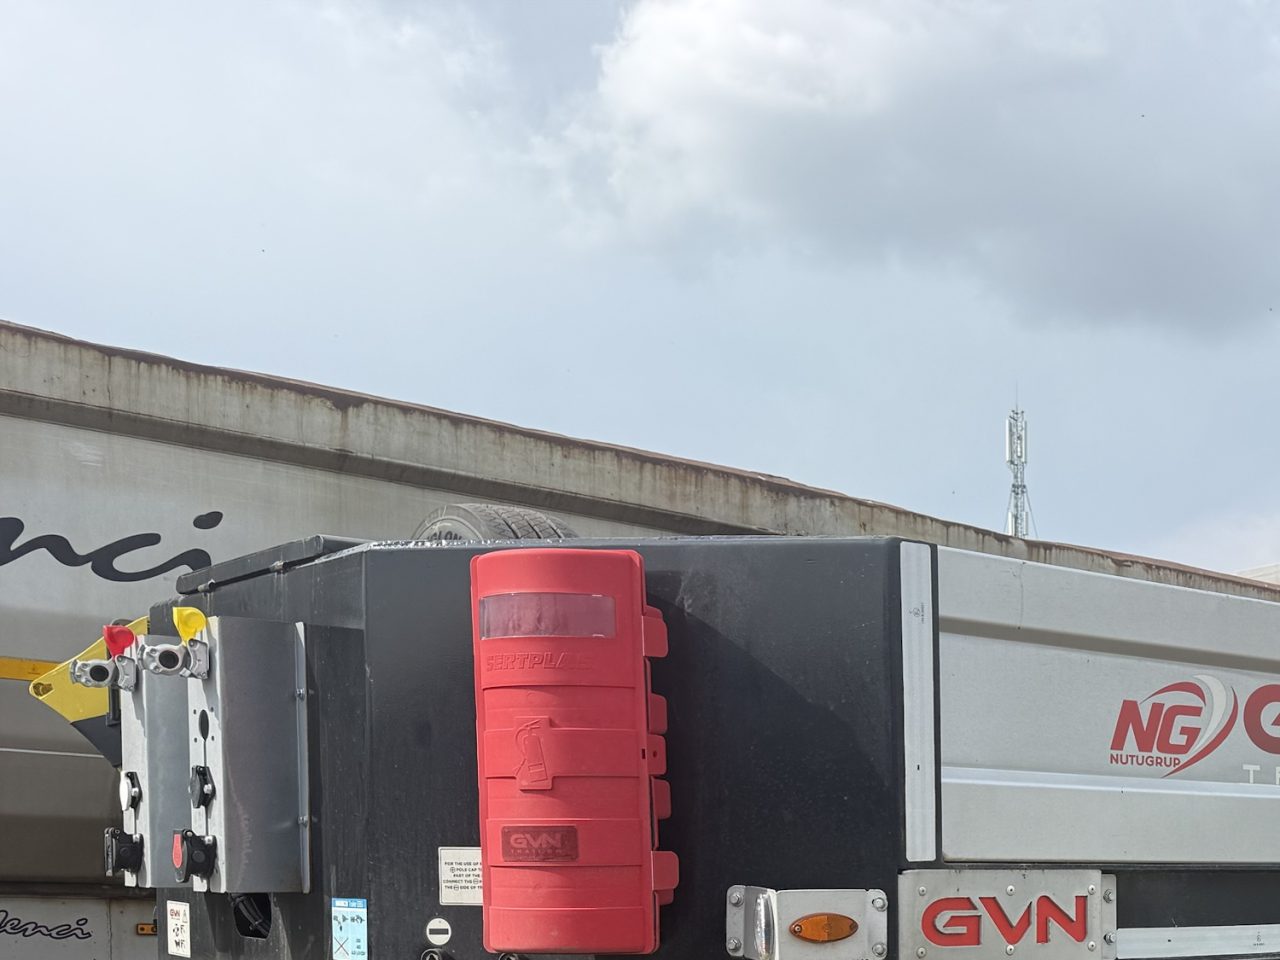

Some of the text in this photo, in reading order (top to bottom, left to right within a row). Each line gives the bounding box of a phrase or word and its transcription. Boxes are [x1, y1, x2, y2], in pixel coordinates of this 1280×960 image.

[1110, 699, 1203, 755] NG
[1110, 753, 1181, 768] NUTUGRUP
[510, 832, 562, 848] GVN
[921, 895, 1088, 947] GVN
